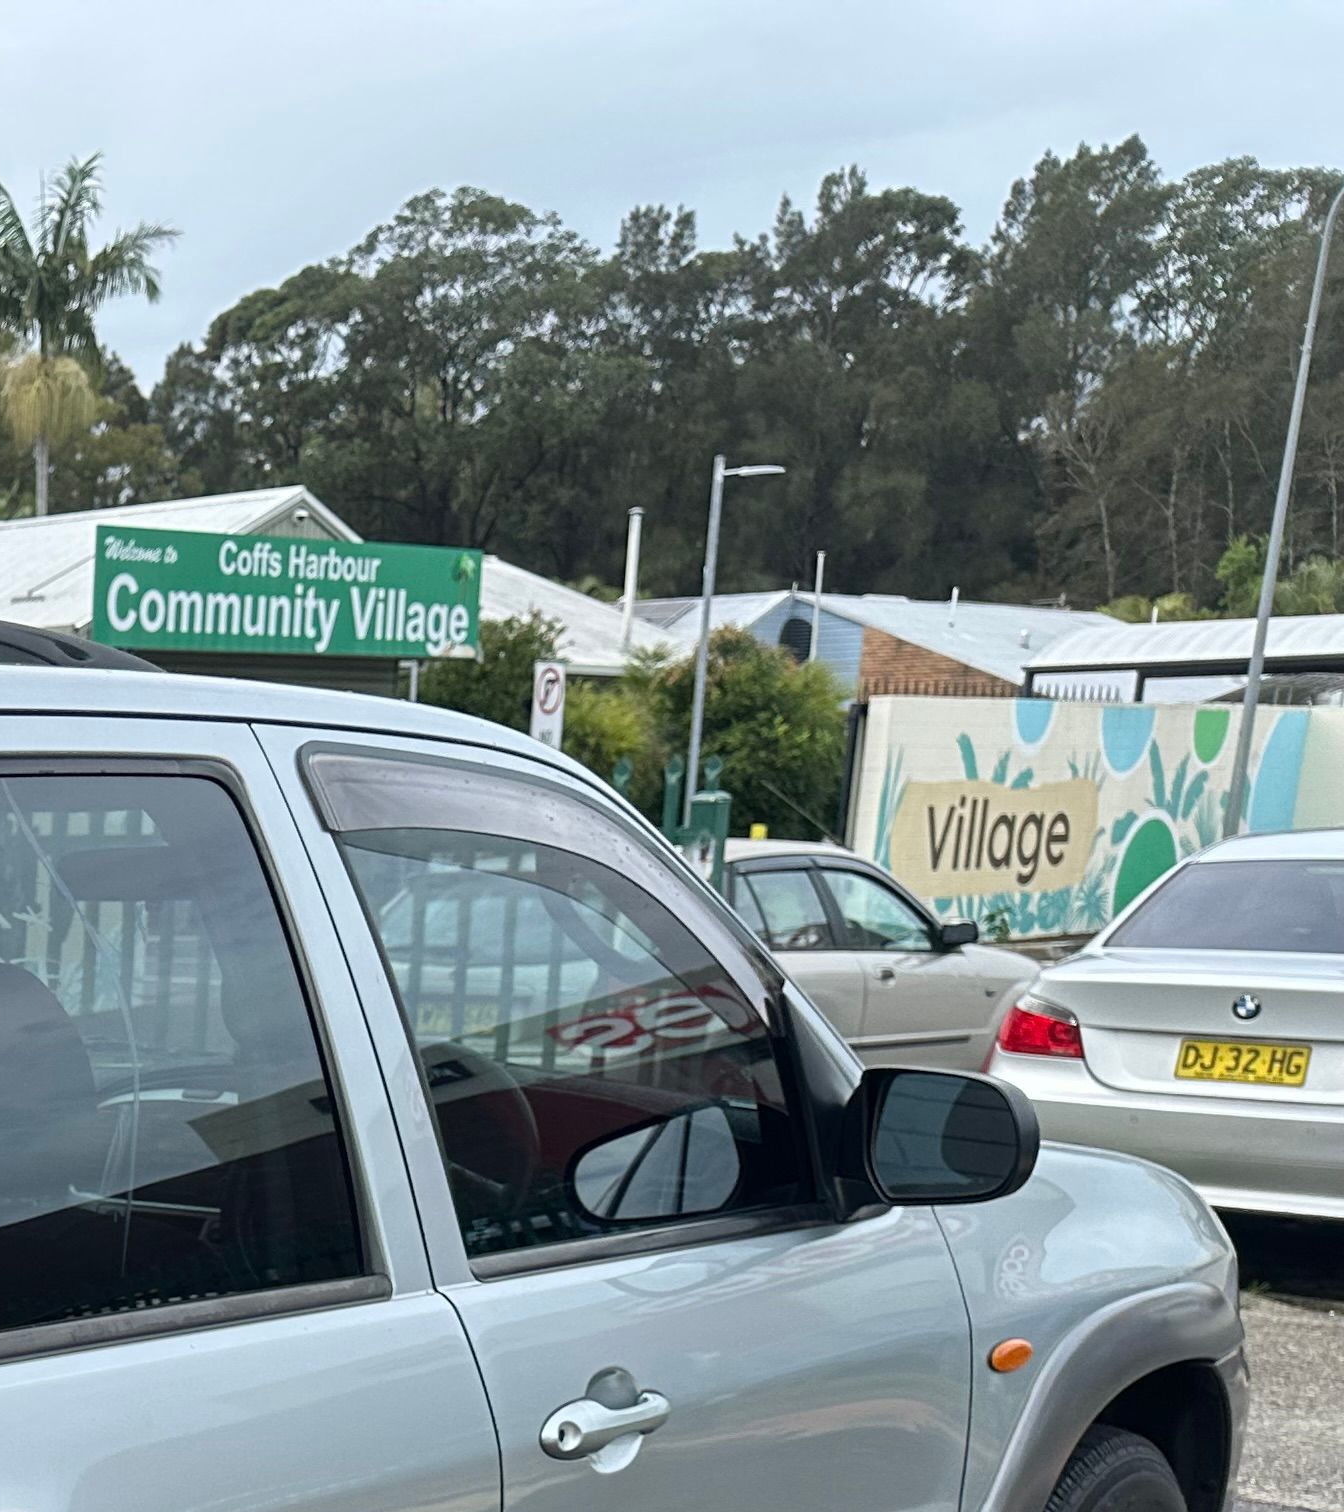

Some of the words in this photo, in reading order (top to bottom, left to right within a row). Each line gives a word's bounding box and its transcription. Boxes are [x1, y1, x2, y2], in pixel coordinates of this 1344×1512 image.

[104, 535, 162, 563] Welcome
[163, 545, 179, 564] to
[219, 540, 283, 578] Coffs
[288, 544, 382, 583] Harbour
[106, 572, 341, 654] Community
[350, 586, 470, 657] Village
